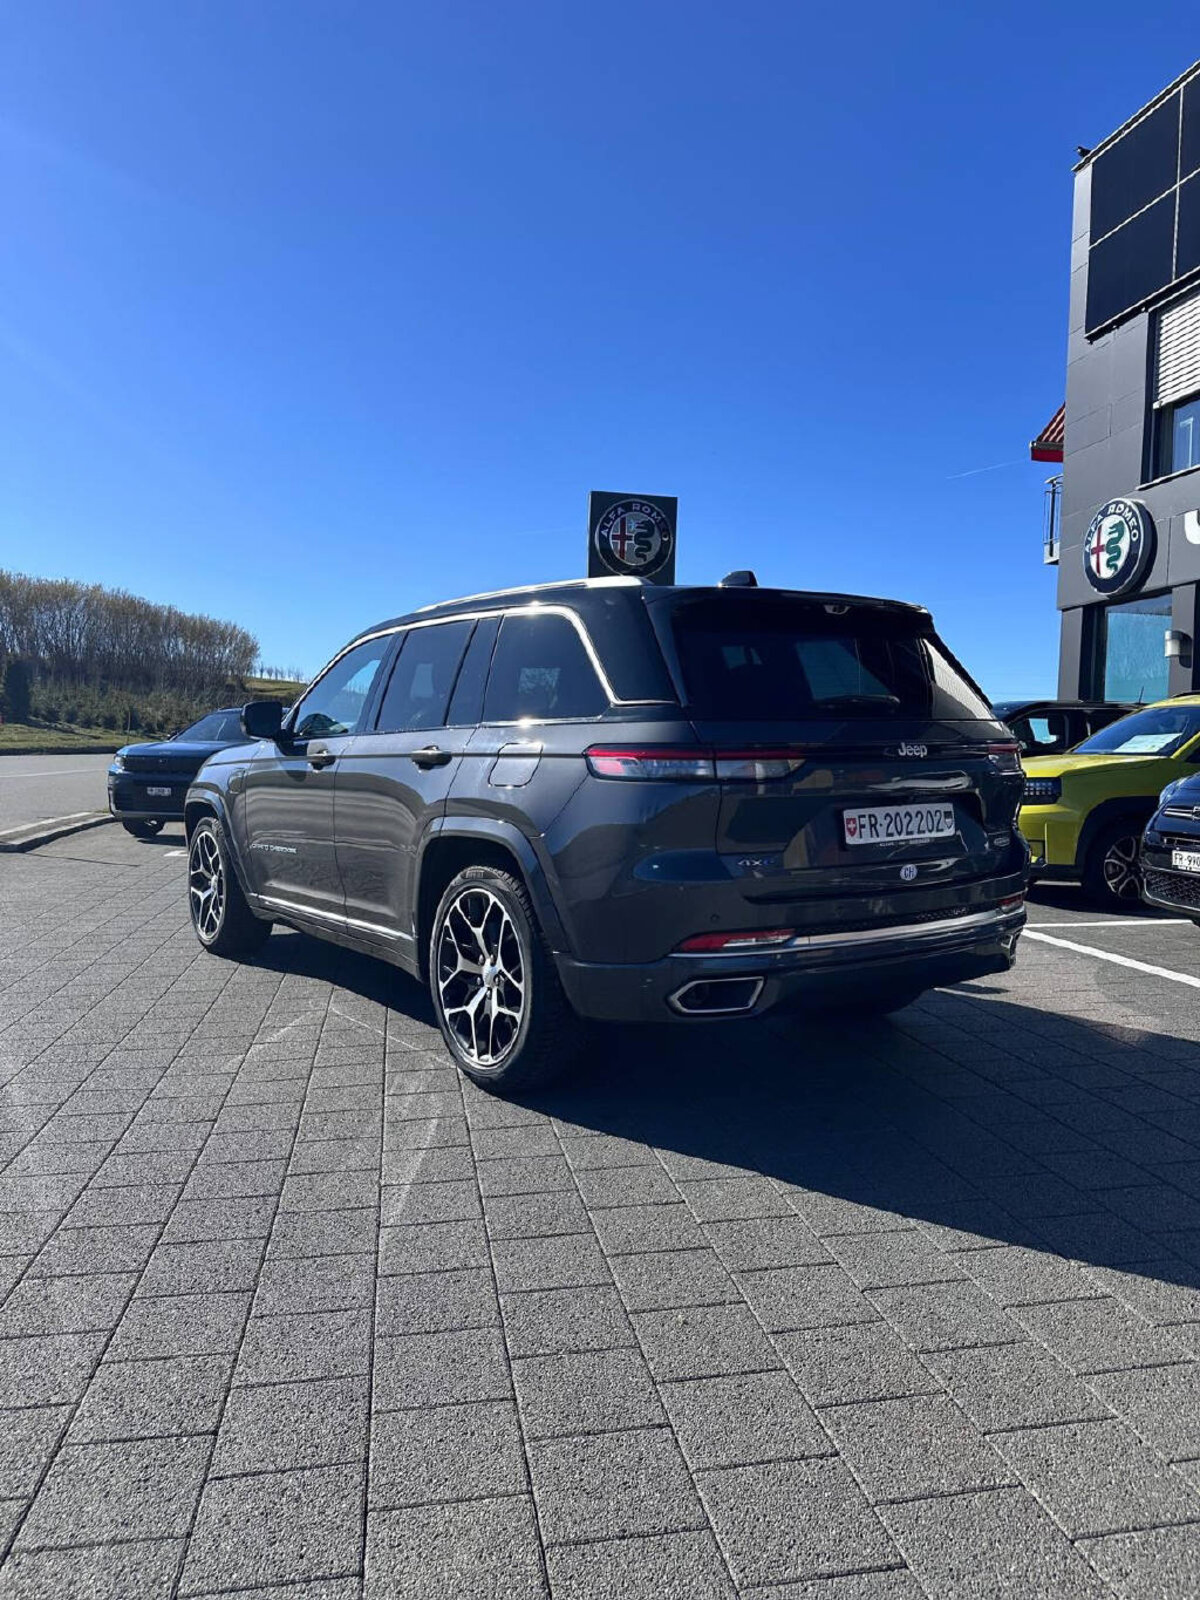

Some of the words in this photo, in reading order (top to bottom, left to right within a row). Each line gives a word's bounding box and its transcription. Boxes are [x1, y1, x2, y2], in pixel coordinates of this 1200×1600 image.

[601, 507, 625, 537] ALFA
[632, 503, 670, 541] ROMO
[1085, 514, 1104, 553] ALFA
[1107, 503, 1139, 542] ROMEO
[898, 742, 928, 758] Jeep
[903, 867, 916, 878] CH
